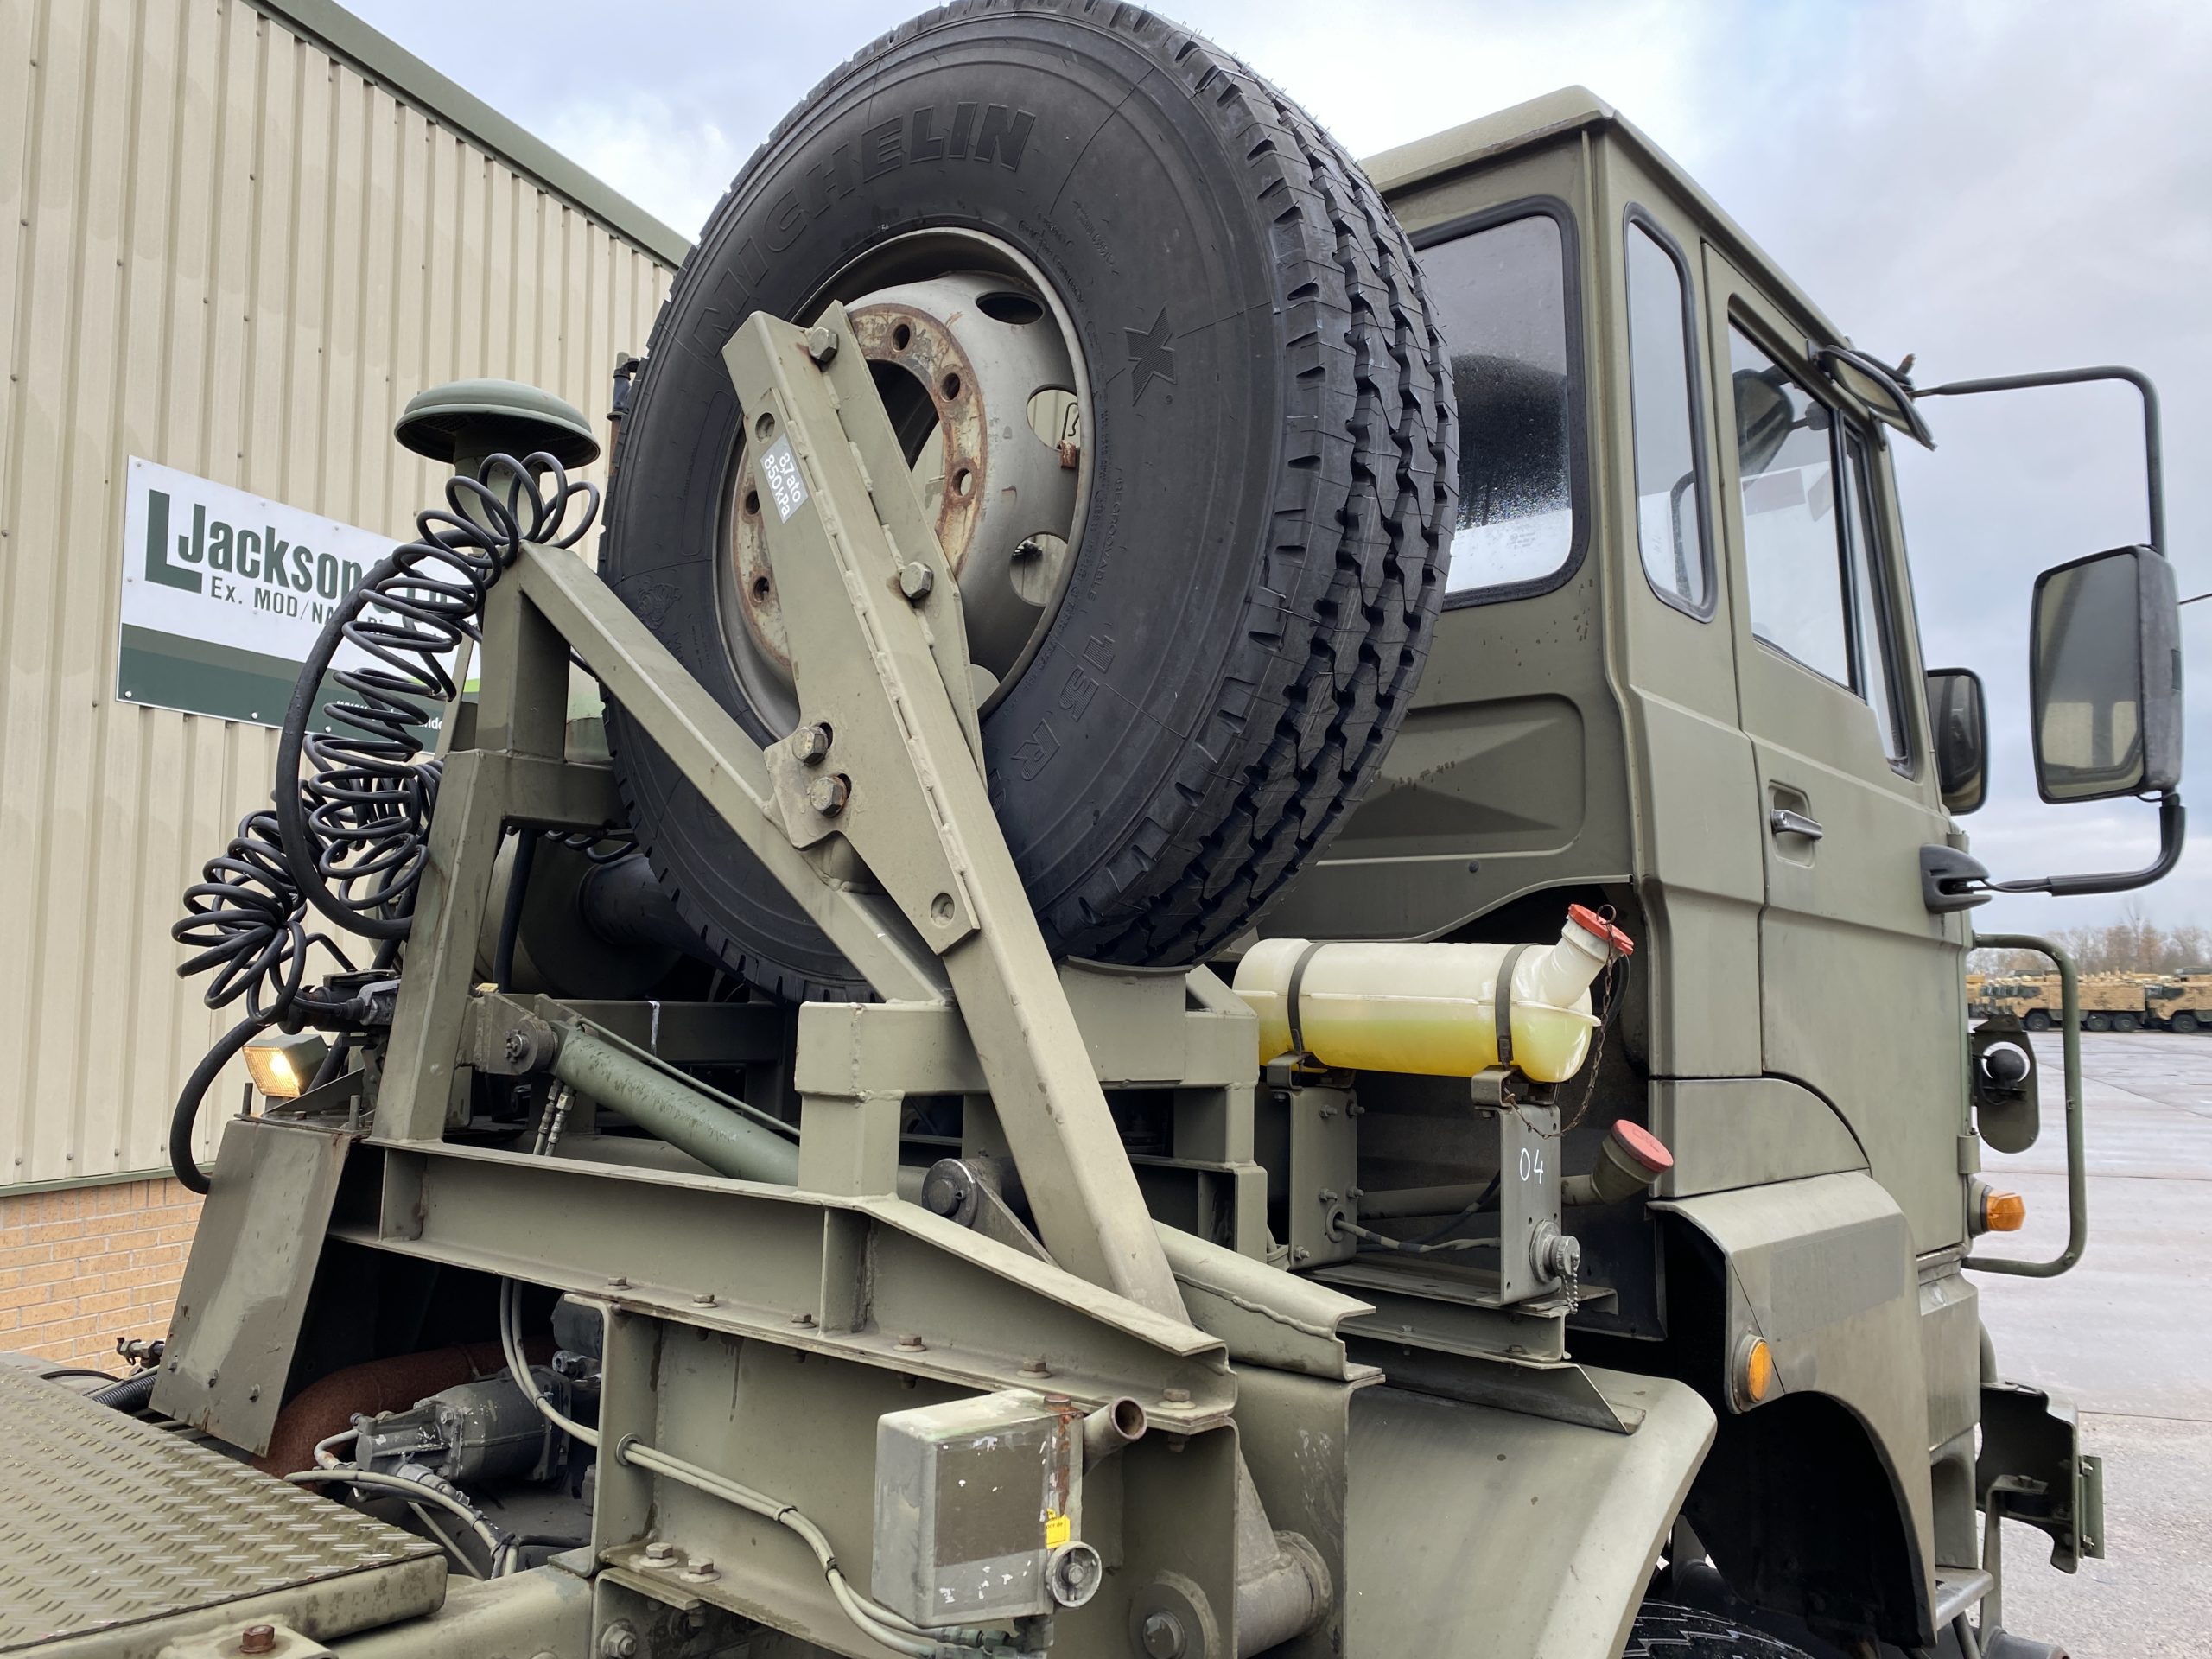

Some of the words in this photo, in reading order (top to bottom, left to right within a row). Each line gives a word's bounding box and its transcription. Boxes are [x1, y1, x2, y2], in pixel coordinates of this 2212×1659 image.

[693, 100, 1037, 359] MICHELIN
[779, 452, 795, 475] 8,7
[786, 474, 801, 503] ato
[177, 502, 363, 603] Jackson
[211, 575, 243, 605] Ex.
[1519, 1147, 1544, 1185] 04
